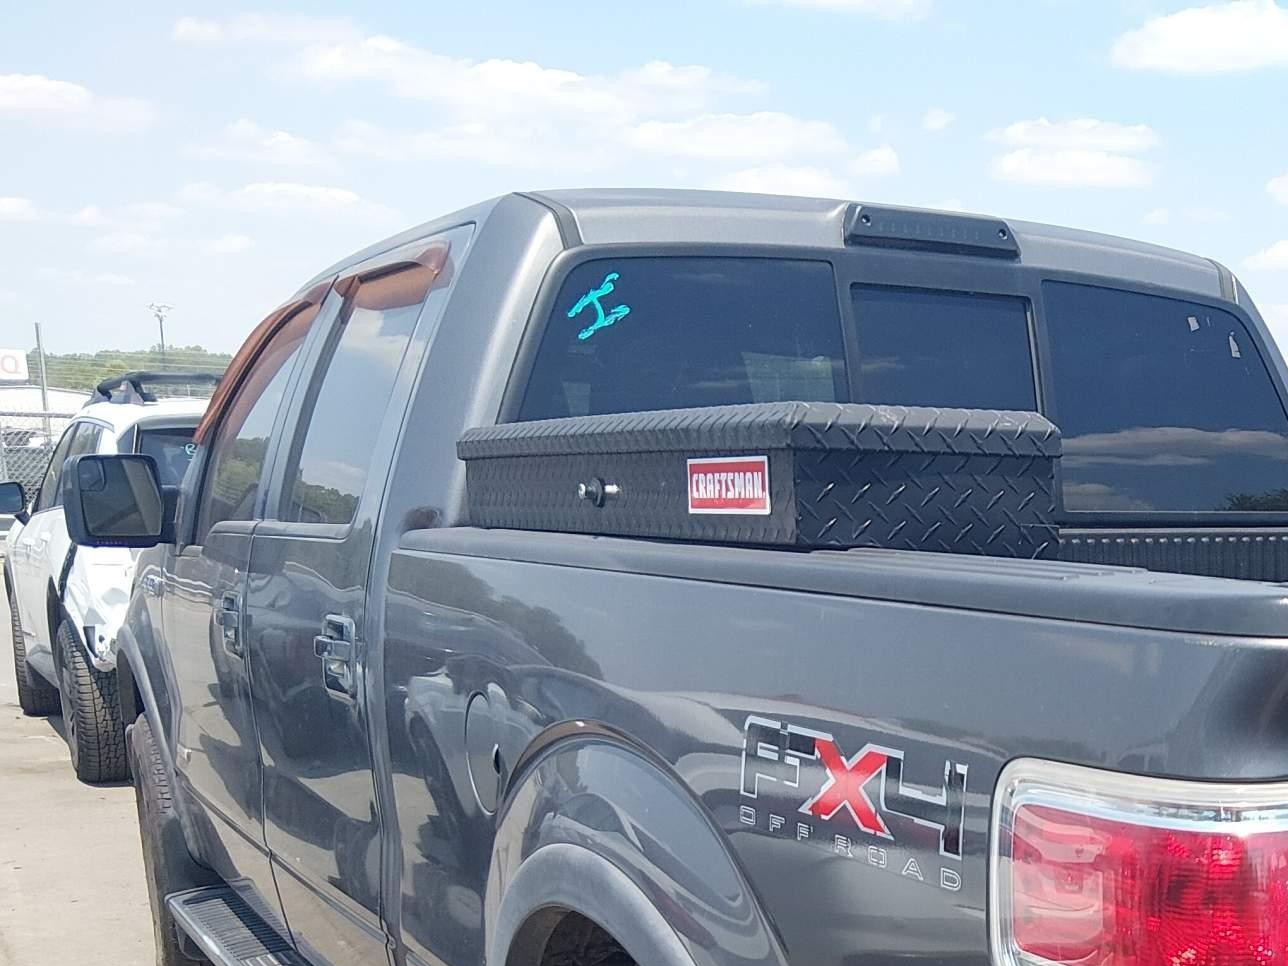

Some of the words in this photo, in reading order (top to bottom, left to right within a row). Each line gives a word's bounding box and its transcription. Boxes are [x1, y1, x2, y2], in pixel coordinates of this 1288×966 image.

[739, 714, 969, 861] FX4
[739, 805, 814, 842] OFF
[834, 833, 963, 893] ROAD
